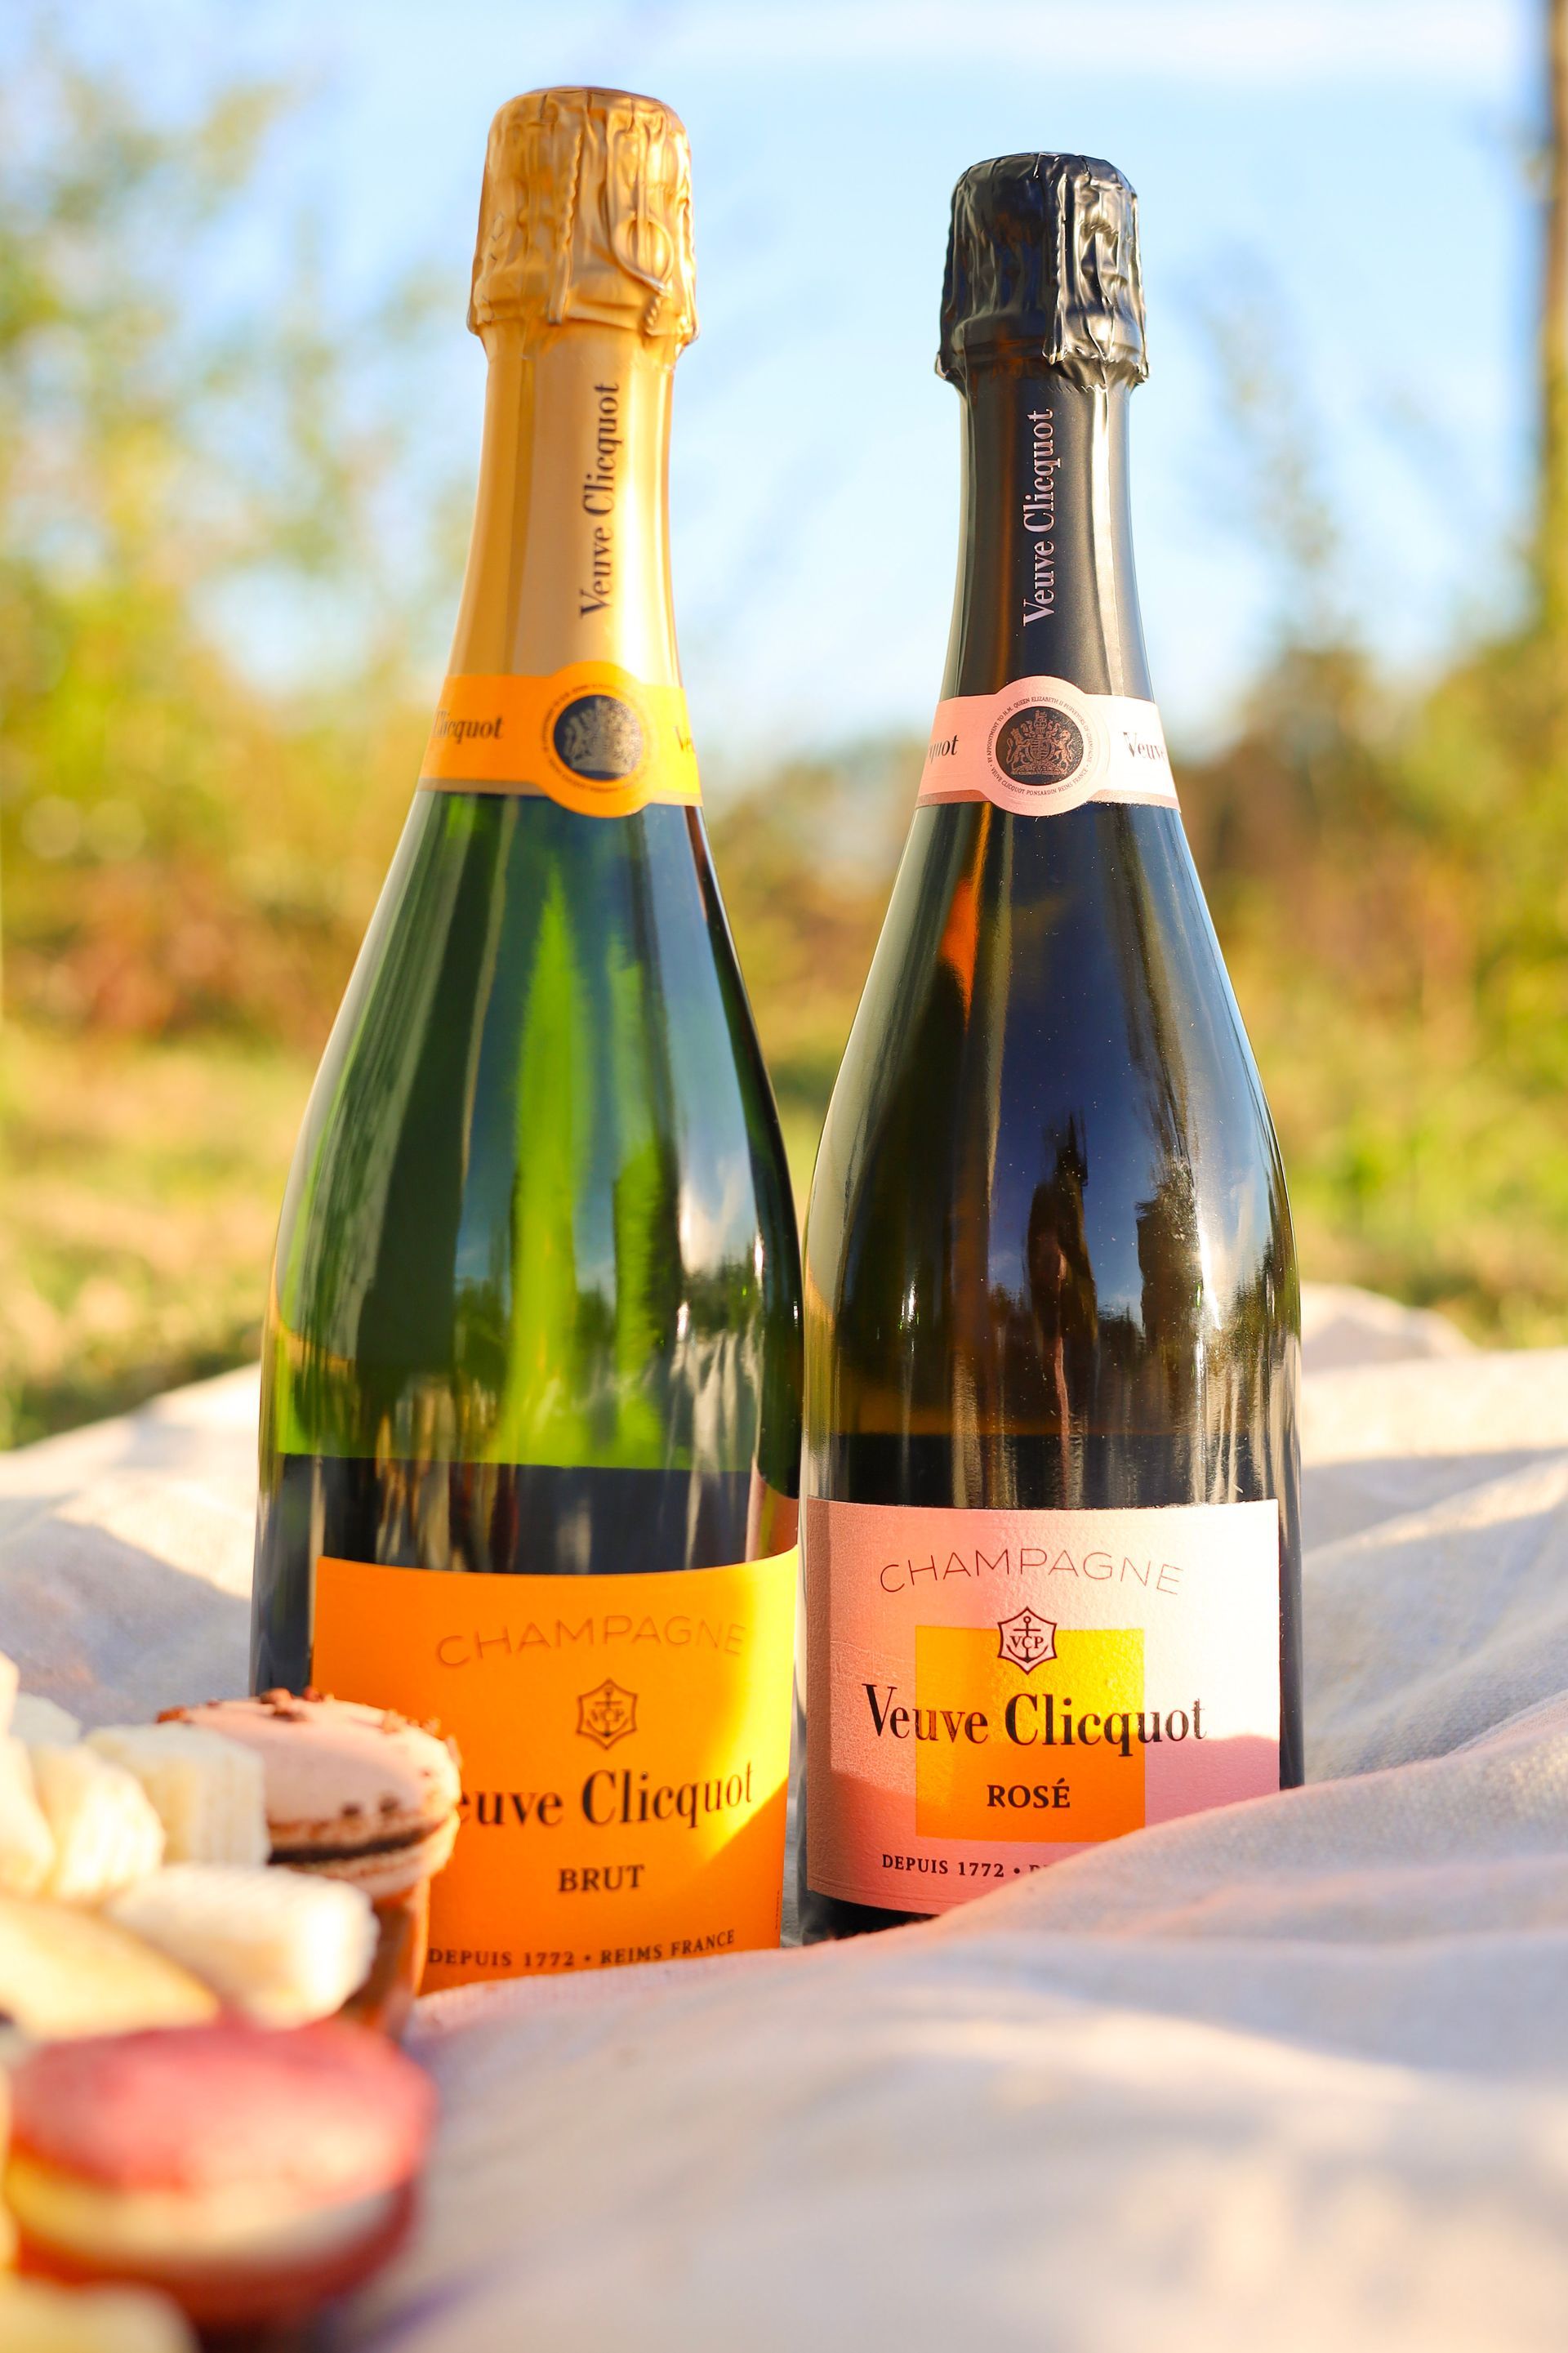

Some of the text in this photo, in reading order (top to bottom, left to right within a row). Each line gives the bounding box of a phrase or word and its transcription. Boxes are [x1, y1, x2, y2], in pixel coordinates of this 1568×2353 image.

[579, 382, 623, 618] Veuve Clicquot
[1022, 408, 1062, 626] Veuve Clicquot
[1013, 697, 1030, 709] QUEEN
[880, 1548, 1183, 1596] CHAMPAGNE
[435, 1615, 747, 1668] CHAMPAGNE
[1009, 1635, 1045, 1649] VCP
[862, 1683, 1207, 1757] Veuve Clicquot
[581, 1761, 753, 1828] Clicquot
[987, 1777, 1071, 1809] ROSÉ
[558, 1864, 645, 1892] BRUT
[882, 1854, 1004, 1878] DEPUIS 1772
[429, 1927, 735, 1968] DEPUIS 1772 REIMS FRANCE
